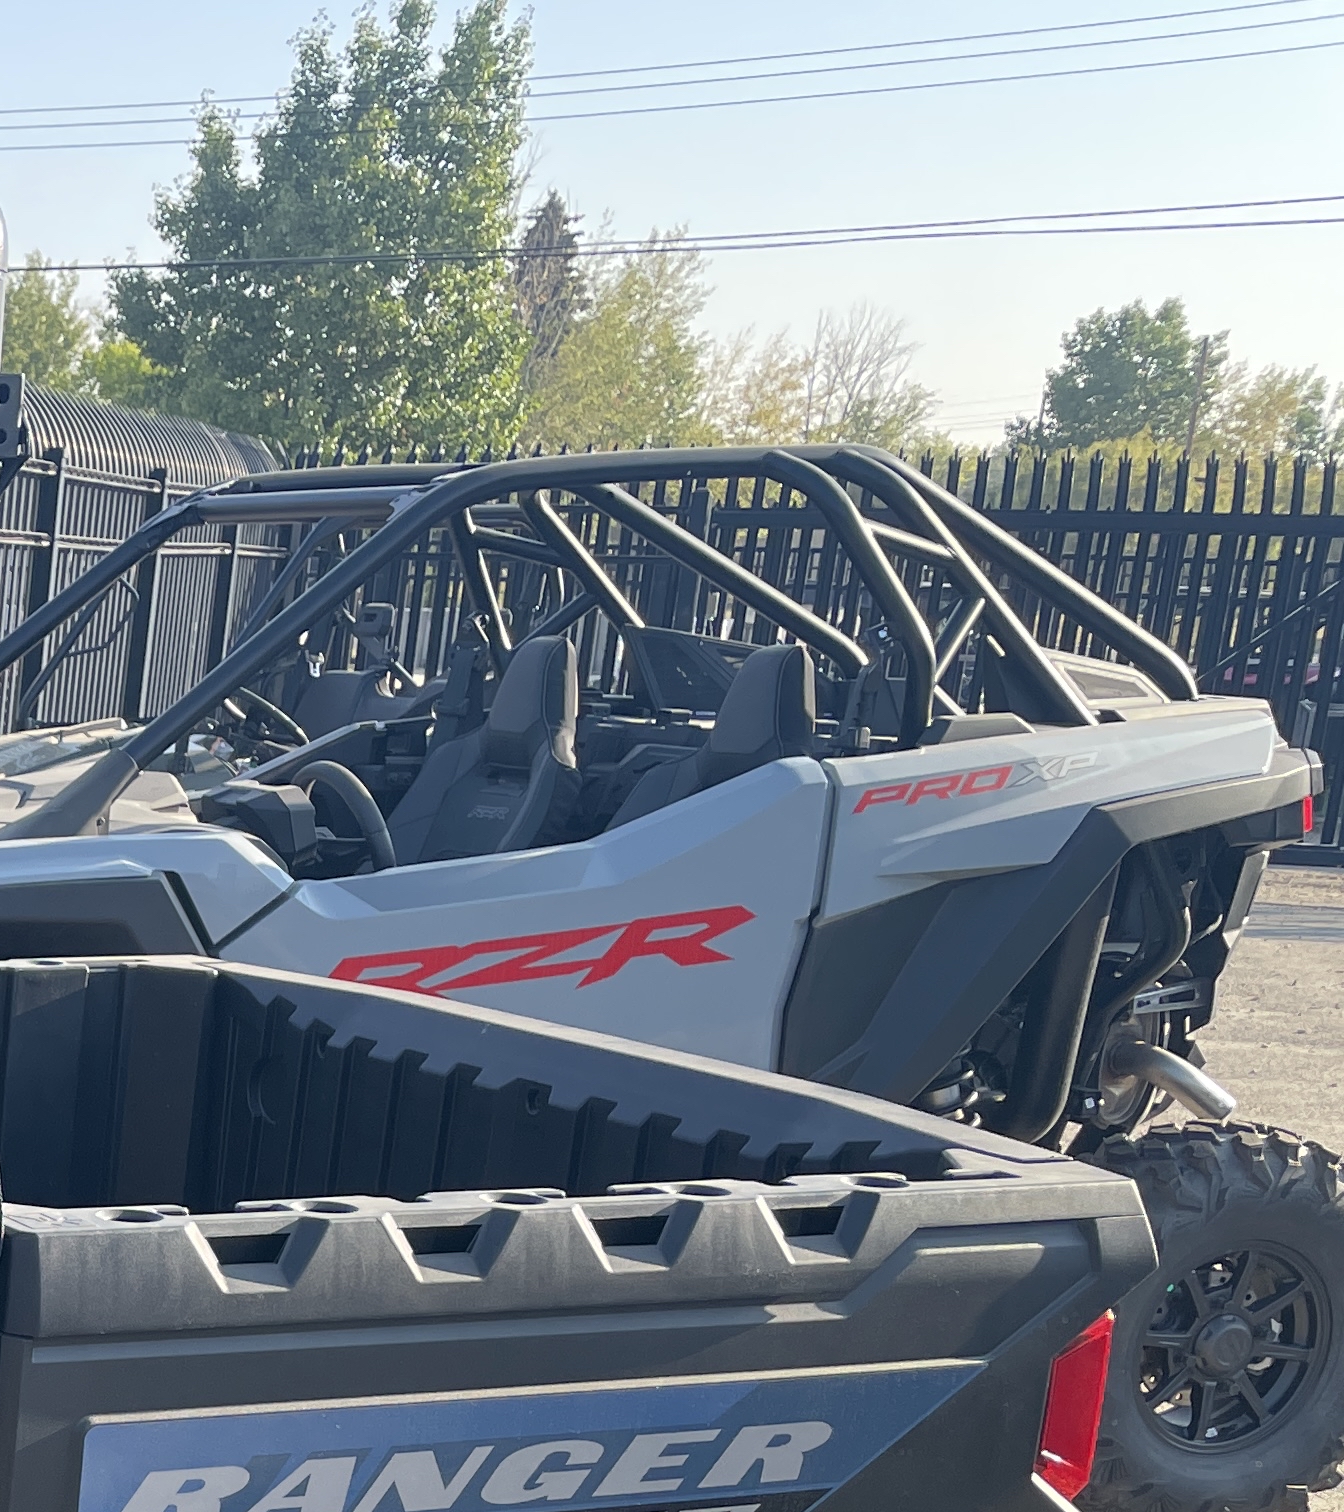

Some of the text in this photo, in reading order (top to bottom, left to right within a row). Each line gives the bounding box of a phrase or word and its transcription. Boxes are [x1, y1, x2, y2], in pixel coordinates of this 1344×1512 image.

[852, 751, 1099, 814] PRO XP
[328, 905, 757, 999] RZR
